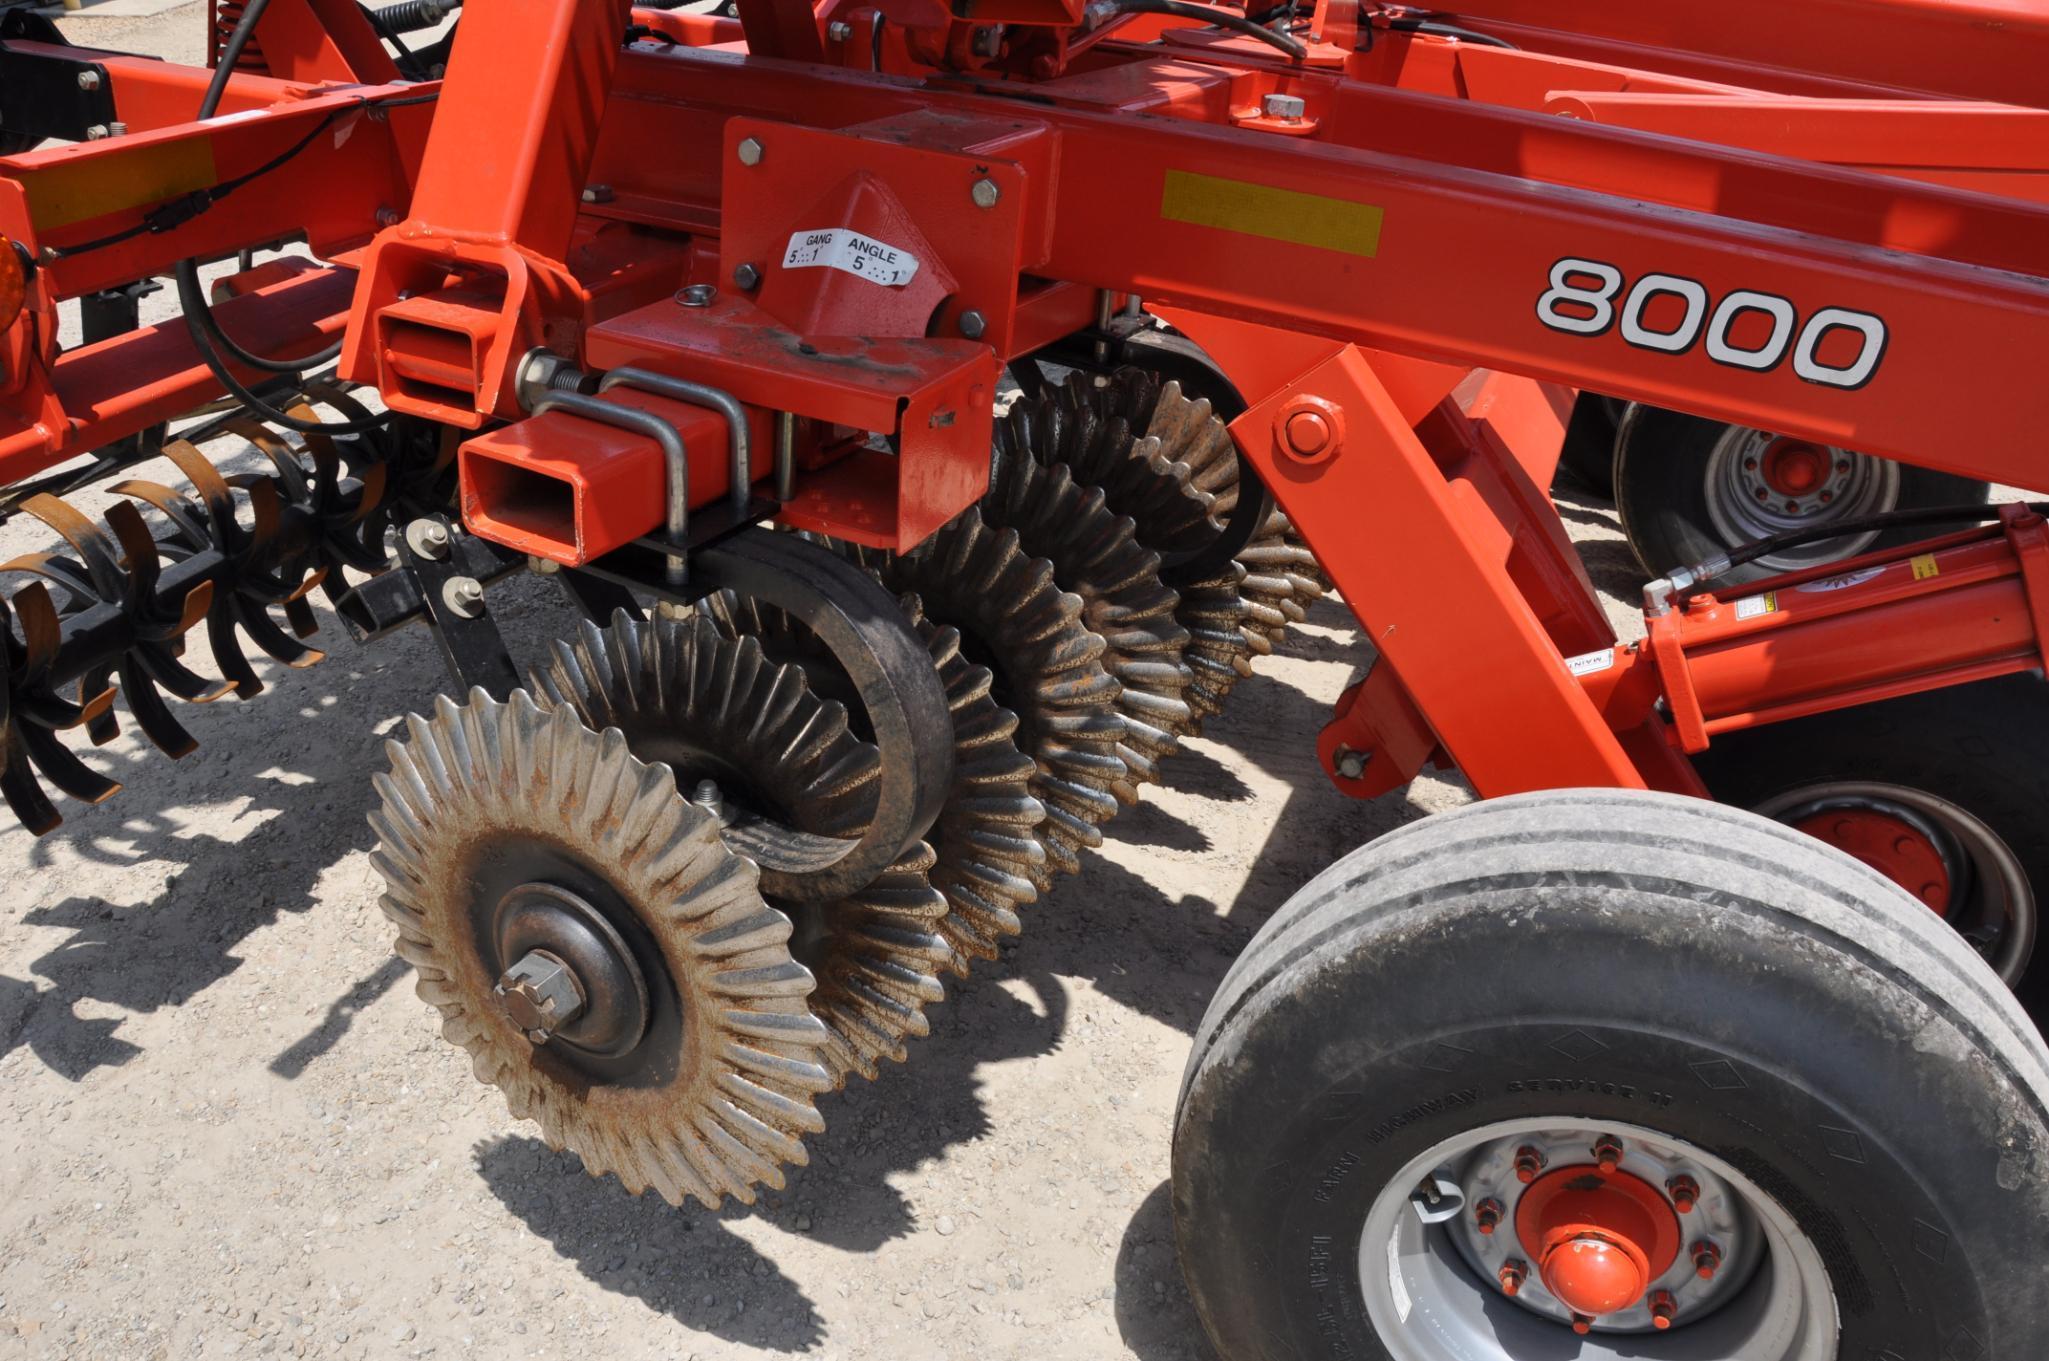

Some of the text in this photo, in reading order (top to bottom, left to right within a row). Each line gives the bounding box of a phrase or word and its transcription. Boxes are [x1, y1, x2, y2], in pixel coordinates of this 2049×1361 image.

[806, 234, 897, 265] GANG ANGLE
[1537, 257, 1889, 391] 8000
[1507, 1079, 1637, 1099] SERVICE
